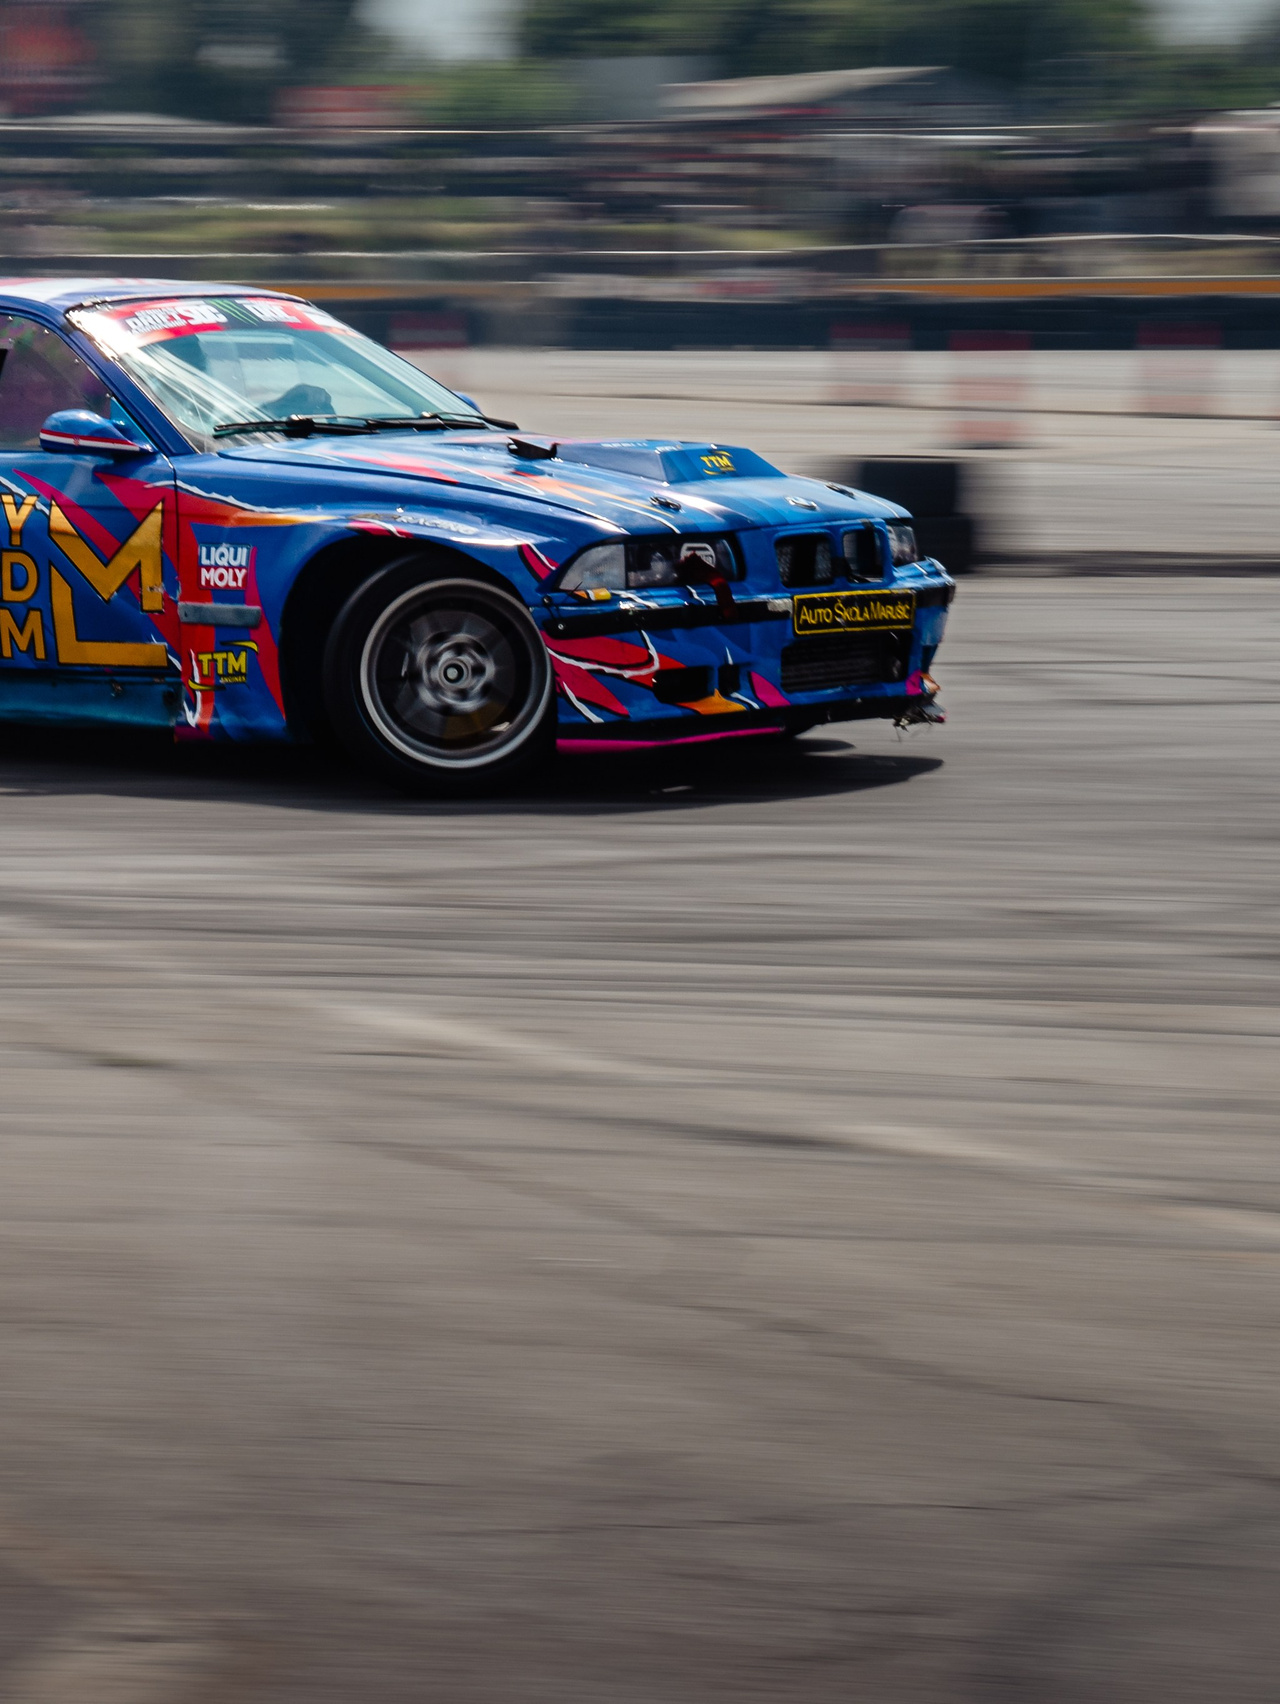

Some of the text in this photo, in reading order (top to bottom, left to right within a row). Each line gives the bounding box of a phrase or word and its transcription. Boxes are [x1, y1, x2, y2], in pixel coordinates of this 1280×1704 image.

[700, 455, 733, 469] TTM
[201, 544, 248, 567] LIQUI
[201, 567, 248, 588] MOLY
[198, 650, 247, 676] TTM
